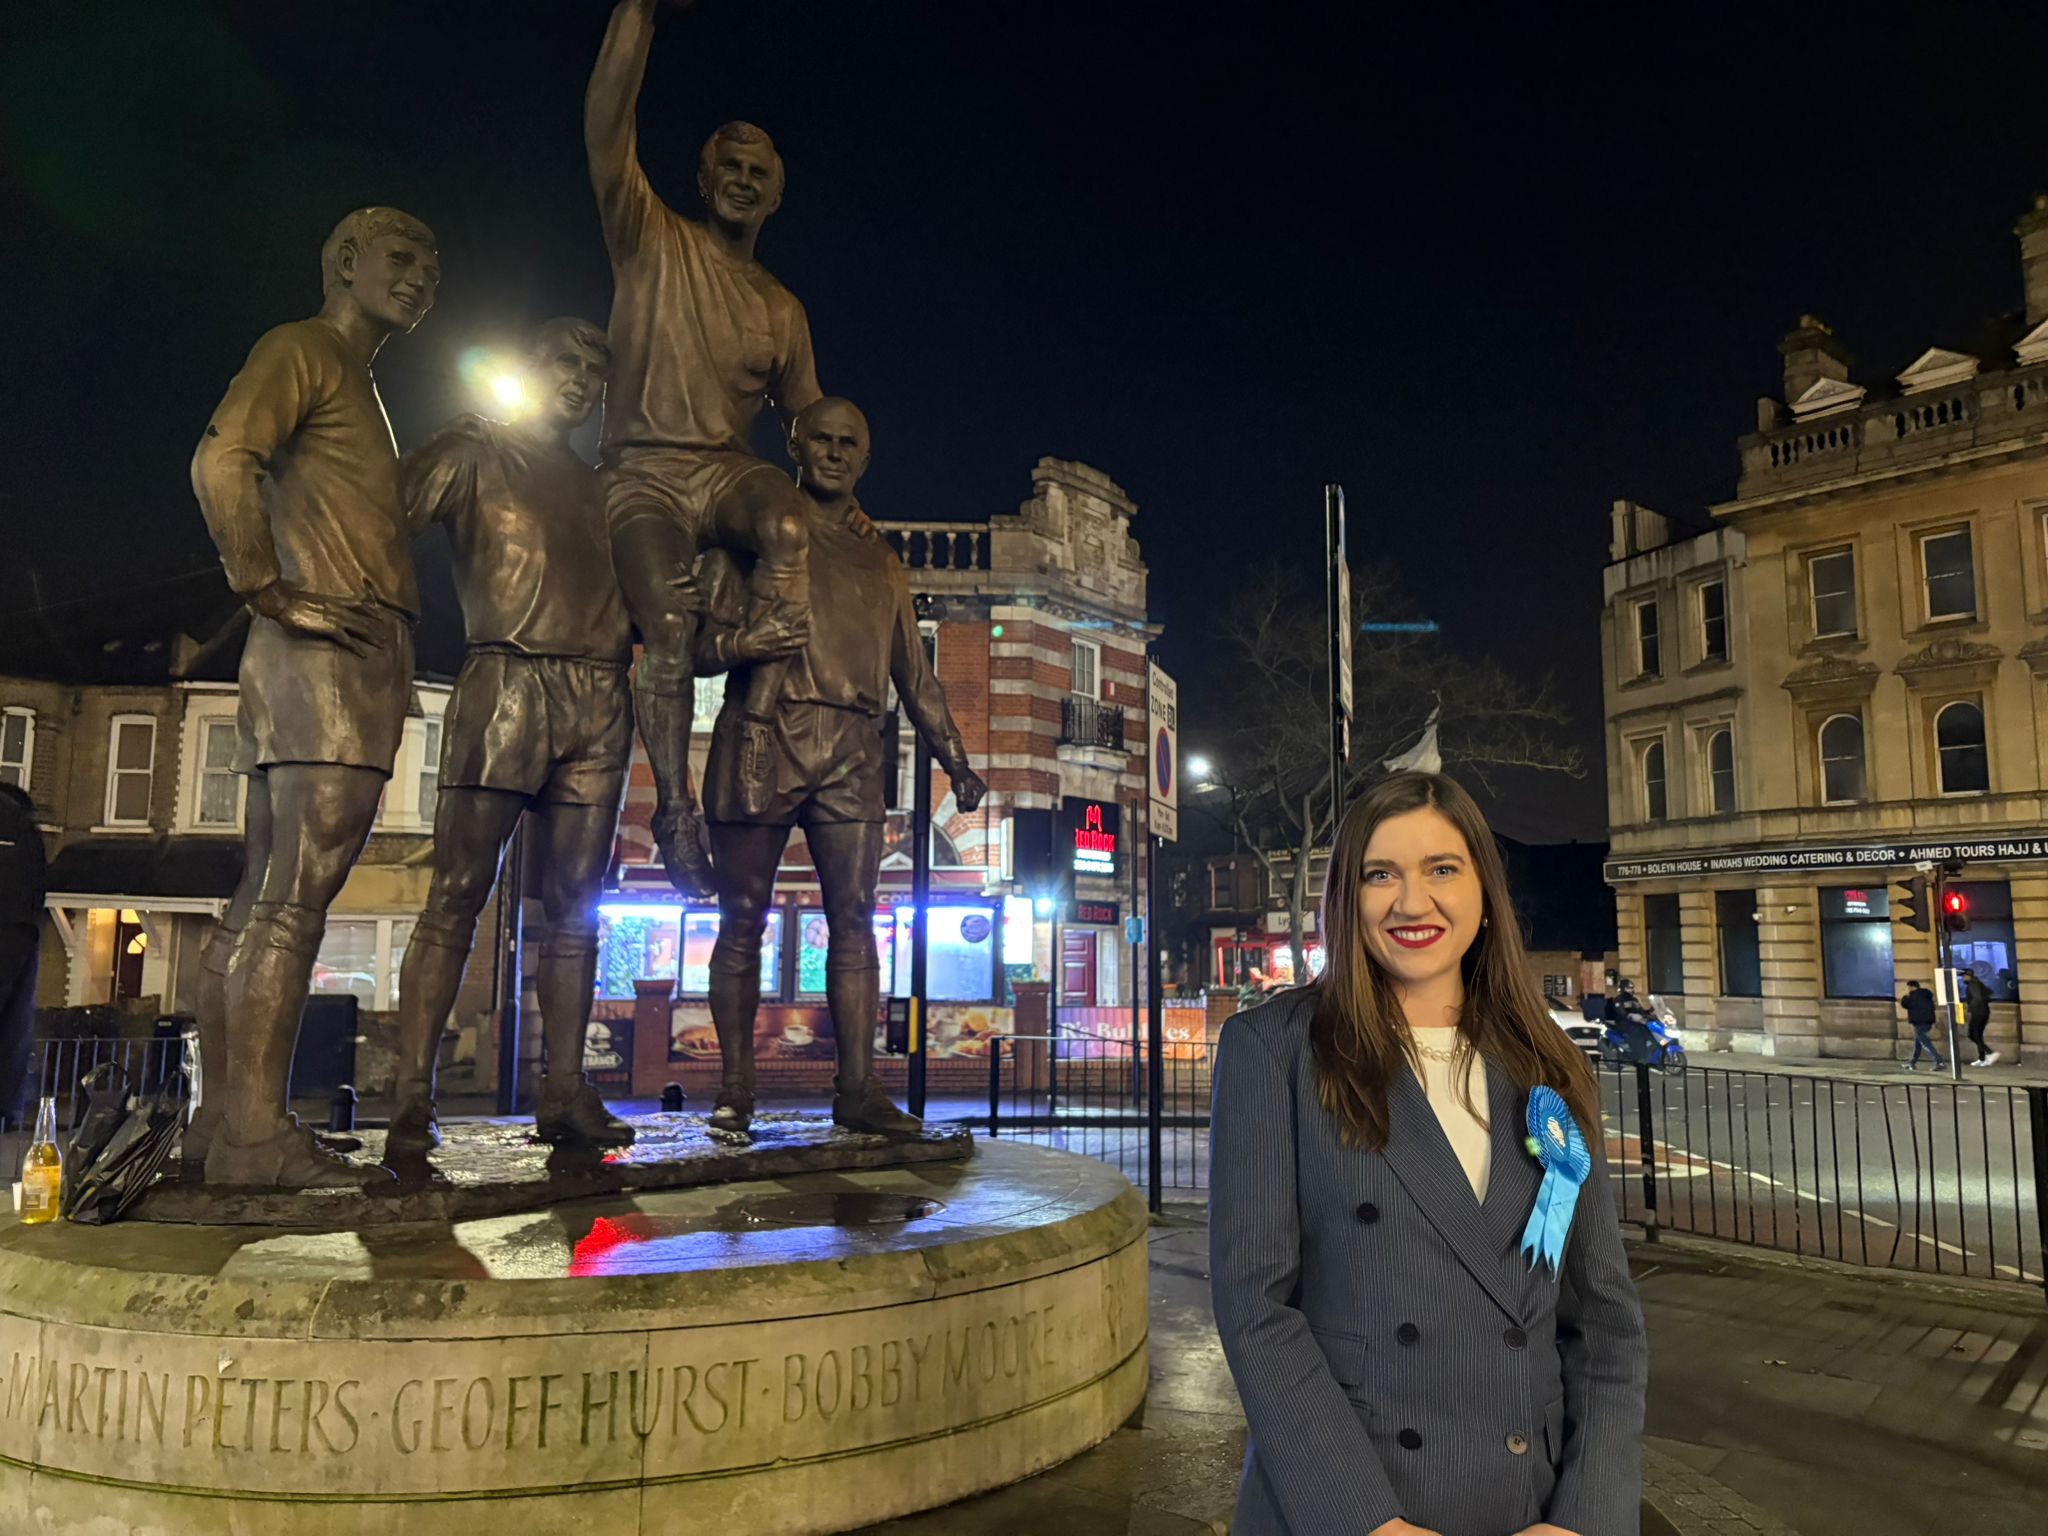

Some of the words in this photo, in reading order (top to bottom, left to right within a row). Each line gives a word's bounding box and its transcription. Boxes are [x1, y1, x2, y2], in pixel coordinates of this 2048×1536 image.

[1151, 695, 1166, 722] ZONE
[1091, 830, 1115, 853] ROCK
[1648, 863, 1676, 875] BOLEYN
[1677, 861, 1702, 873] HOUSE
[1710, 858, 1742, 869] INAYAHS
[1743, 854, 1788, 867] WEDDING
[1790, 851, 1843, 865] CATERING
[1846, 851, 1854, 863] &
[1857, 850, 1896, 862] DECOR
[1909, 847, 1951, 860] AHMED
[1954, 845, 1996, 858] TOURS
[1998, 843, 2029, 856] HAJJ
[2033, 842, 2042, 854] &
[1094, 905, 1112, 921] ROCK
[1060, 1021, 1089, 1039] R's
[1096, 1022, 1190, 1041] Bues
[6, 1352, 170, 1444] MARTIN
[183, 1374, 360, 1456] PETERS
[392, 1374, 565, 1455] GEOFF
[580, 1358, 760, 1446] HURST
[783, 1334, 932, 1423] BOBBY
[942, 1306, 1054, 1397] MOORE
